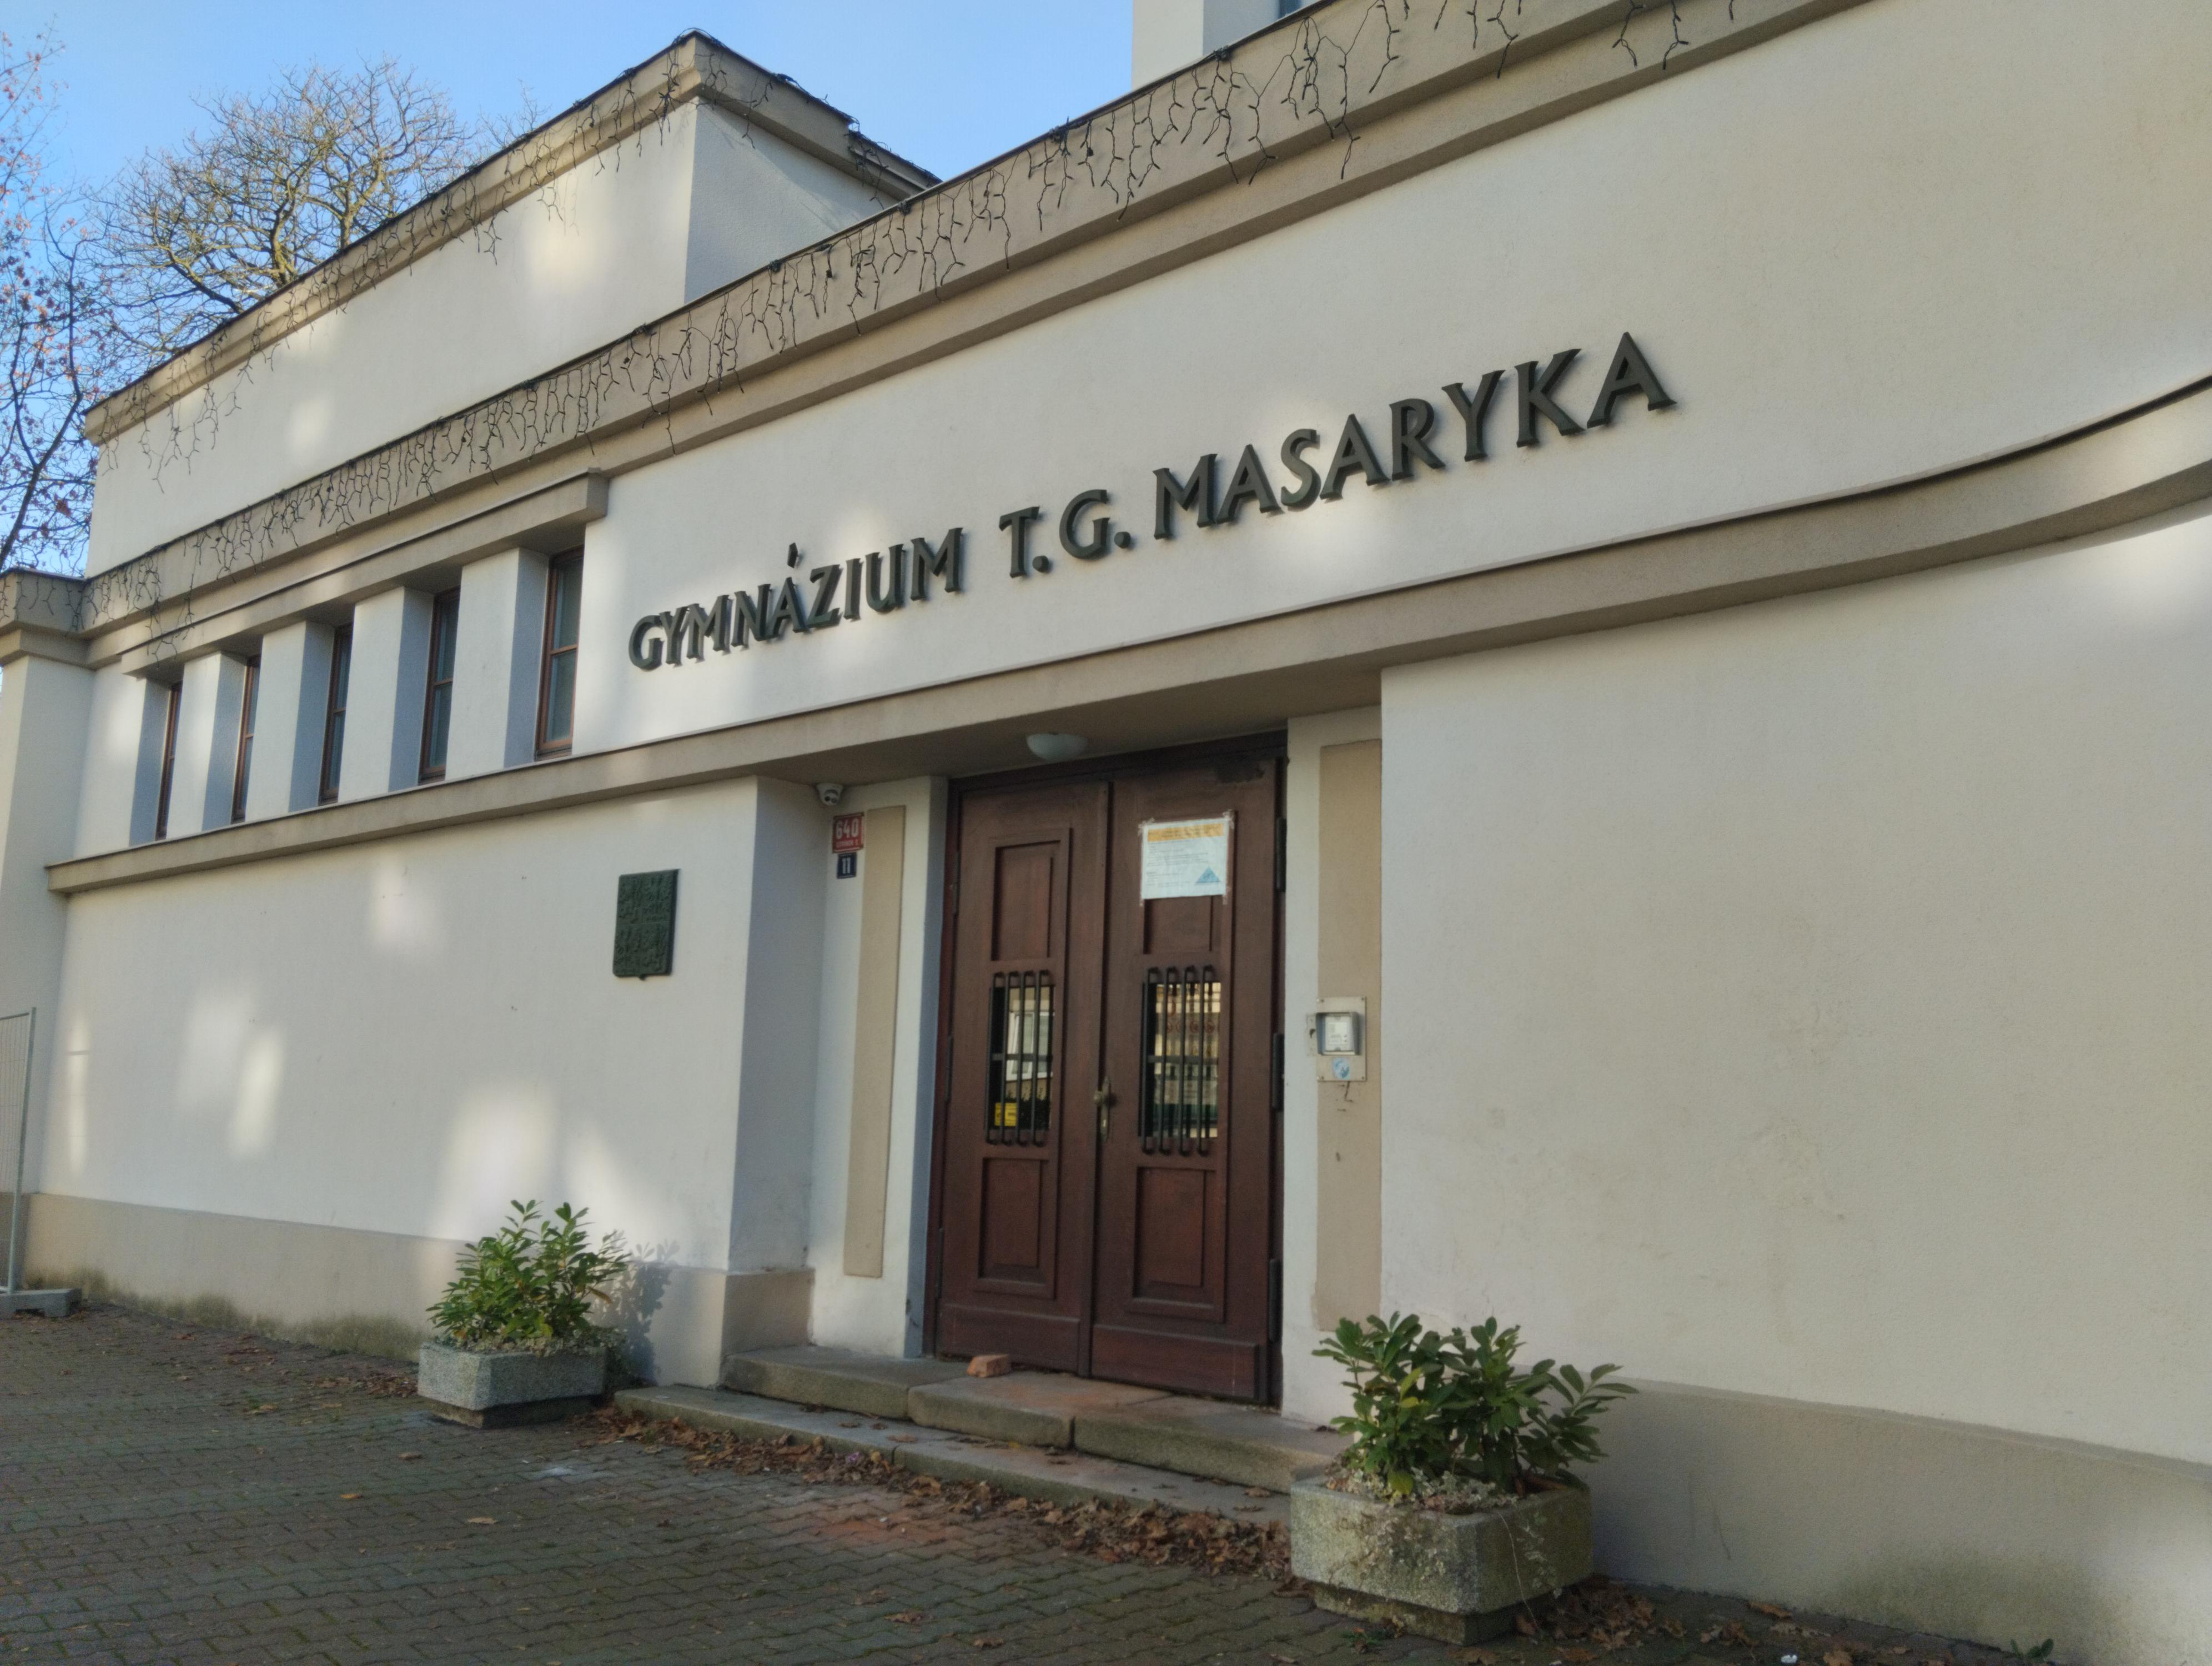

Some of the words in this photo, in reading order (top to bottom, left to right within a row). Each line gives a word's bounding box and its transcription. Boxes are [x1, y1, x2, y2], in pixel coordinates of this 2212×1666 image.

[629, 526, 964, 671] GYMNÁZIUM
[1153, 332, 1677, 540] MASARYKA
[836, 818, 859, 839] 640
[842, 857, 851, 874] 11
